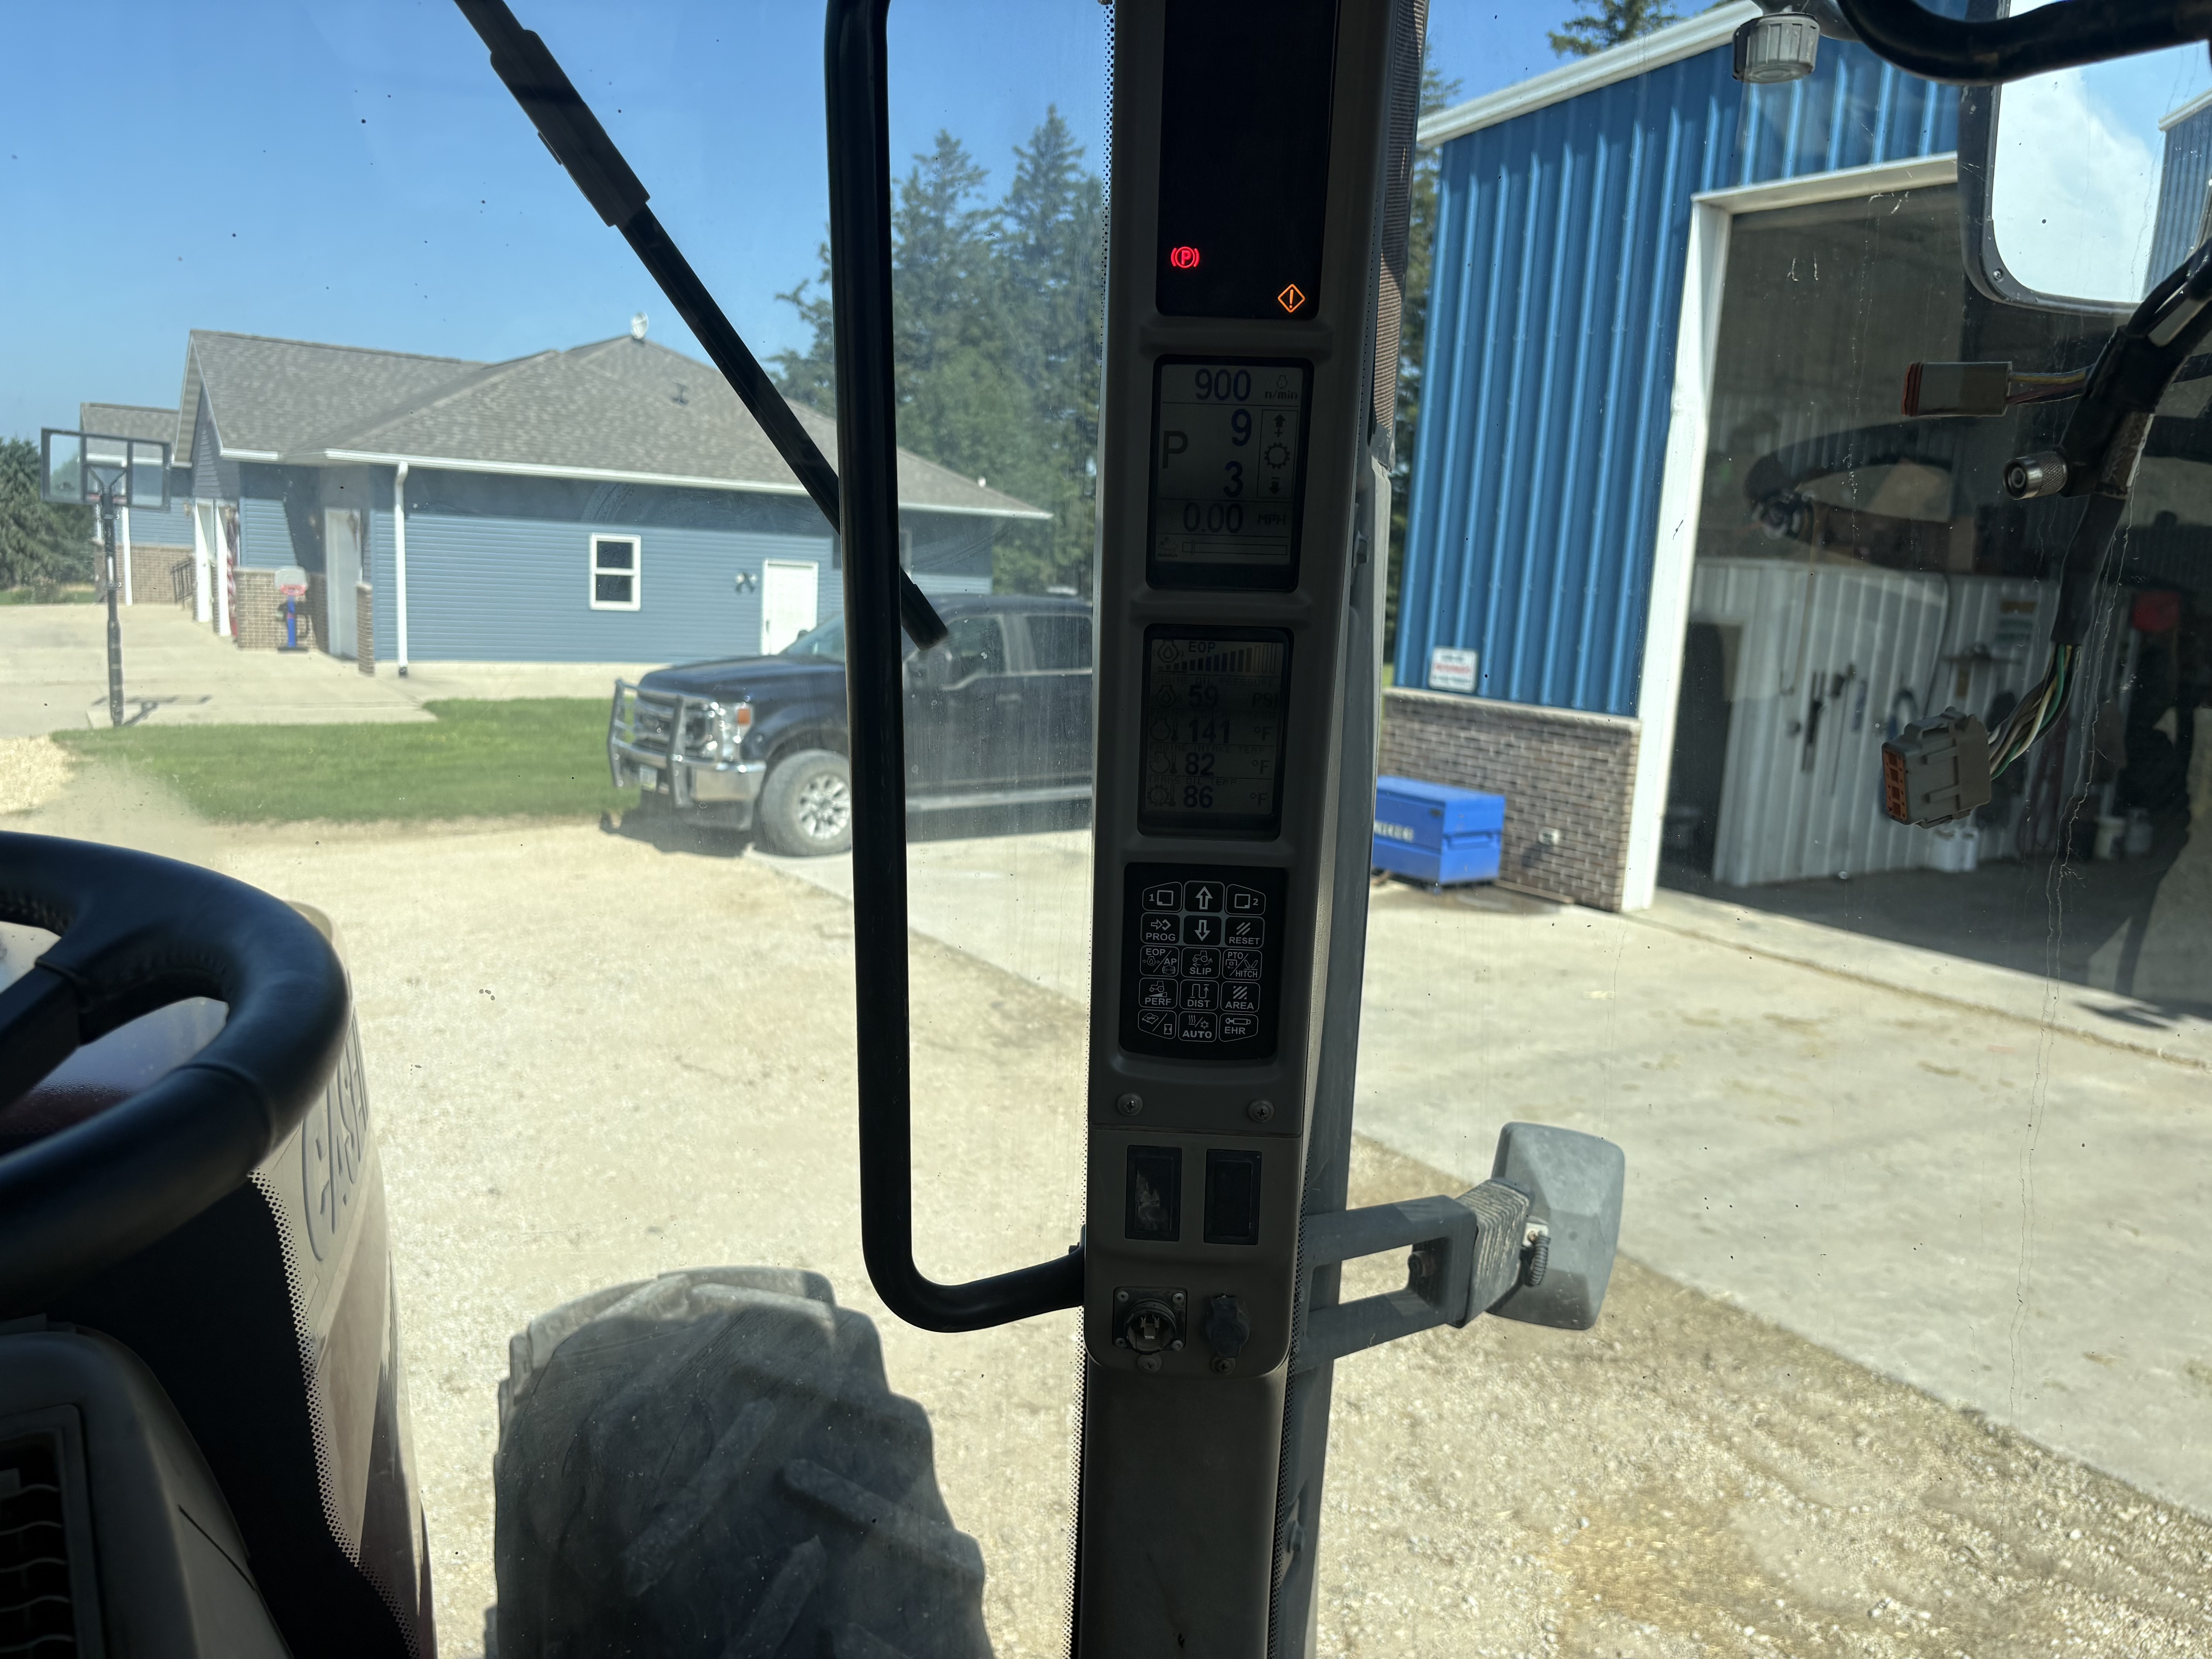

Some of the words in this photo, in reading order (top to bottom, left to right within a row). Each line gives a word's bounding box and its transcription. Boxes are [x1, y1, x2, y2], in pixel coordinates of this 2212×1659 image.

[1195, 369, 1251, 401] 900
[1264, 390, 1298, 400] n/min
[1231, 409, 1252, 447] 9
[1162, 430, 1188, 469] P
[1223, 460, 1243, 497] 3
[1183, 502, 1243, 534] 0.00
[1257, 514, 1286, 525] MPH
[1188, 641, 1216, 653] EOP
[1188, 685, 1219, 708] 59
[1252, 692, 1279, 707] PSI
[1189, 719, 1230, 744] 141
[1149, 744, 1188, 752] ENGINE
[1194, 744, 1231, 753] INTAKE
[1239, 746, 1265, 754] TEMP
[1185, 752, 1215, 776] 82
[1252, 759, 1270, 774] °F
[1148, 776, 1180, 785] TRANS
[1186, 777, 1203, 785] OIL
[1211, 778, 1237, 787] TEMP
[1183, 785, 1213, 808] 86
[1249, 792, 1267, 806] °F
[1146, 933, 1176, 941] PROG
[1228, 936, 1261, 945] RESET
[1227, 951, 1243, 960] PTO
[1235, 970, 1258, 978] HITCH
[1144, 997, 1172, 1006] PERF
[1187, 999, 1211, 1008] DIST
[1225, 1001, 1254, 1010] AREA
[1182, 1030, 1212, 1039] AUTO
[1224, 1026, 1246, 1035] EHR
